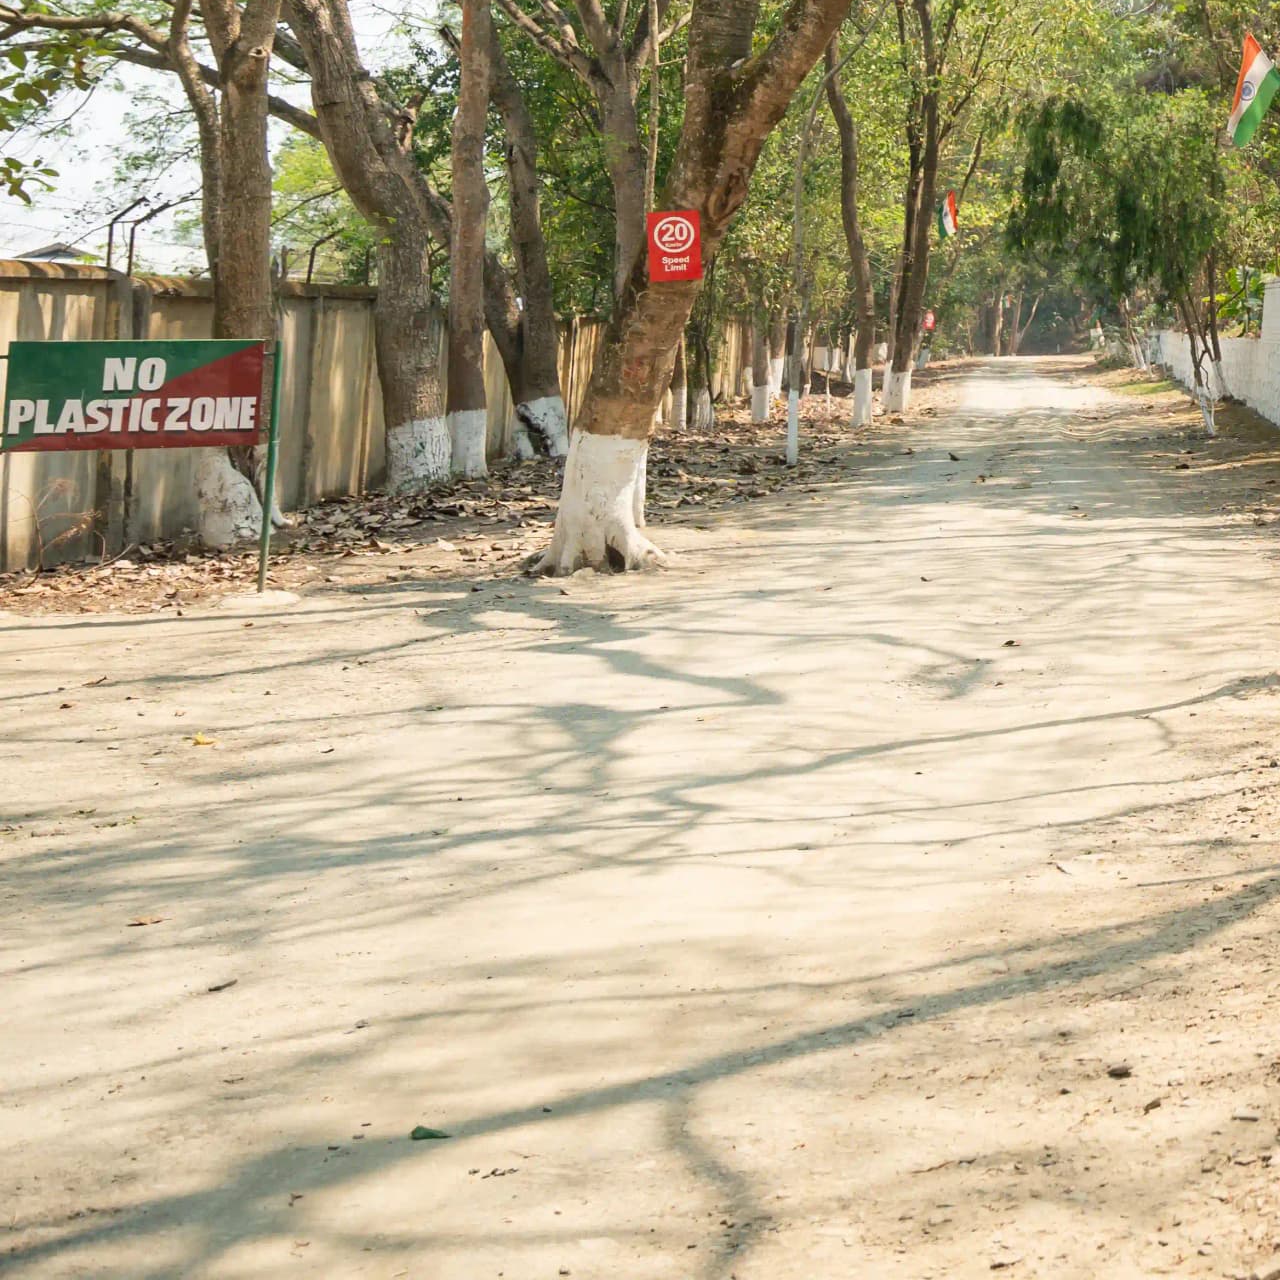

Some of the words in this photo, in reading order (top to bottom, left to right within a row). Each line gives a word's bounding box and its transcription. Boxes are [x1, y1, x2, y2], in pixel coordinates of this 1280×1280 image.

[661, 222, 688, 241] 20
[661, 256, 690, 265] Speed
[664, 264, 687, 272] Limit
[102, 357, 167, 391] NO
[7, 398, 161, 434] PLASTIC
[164, 396, 257, 431] ZONE
